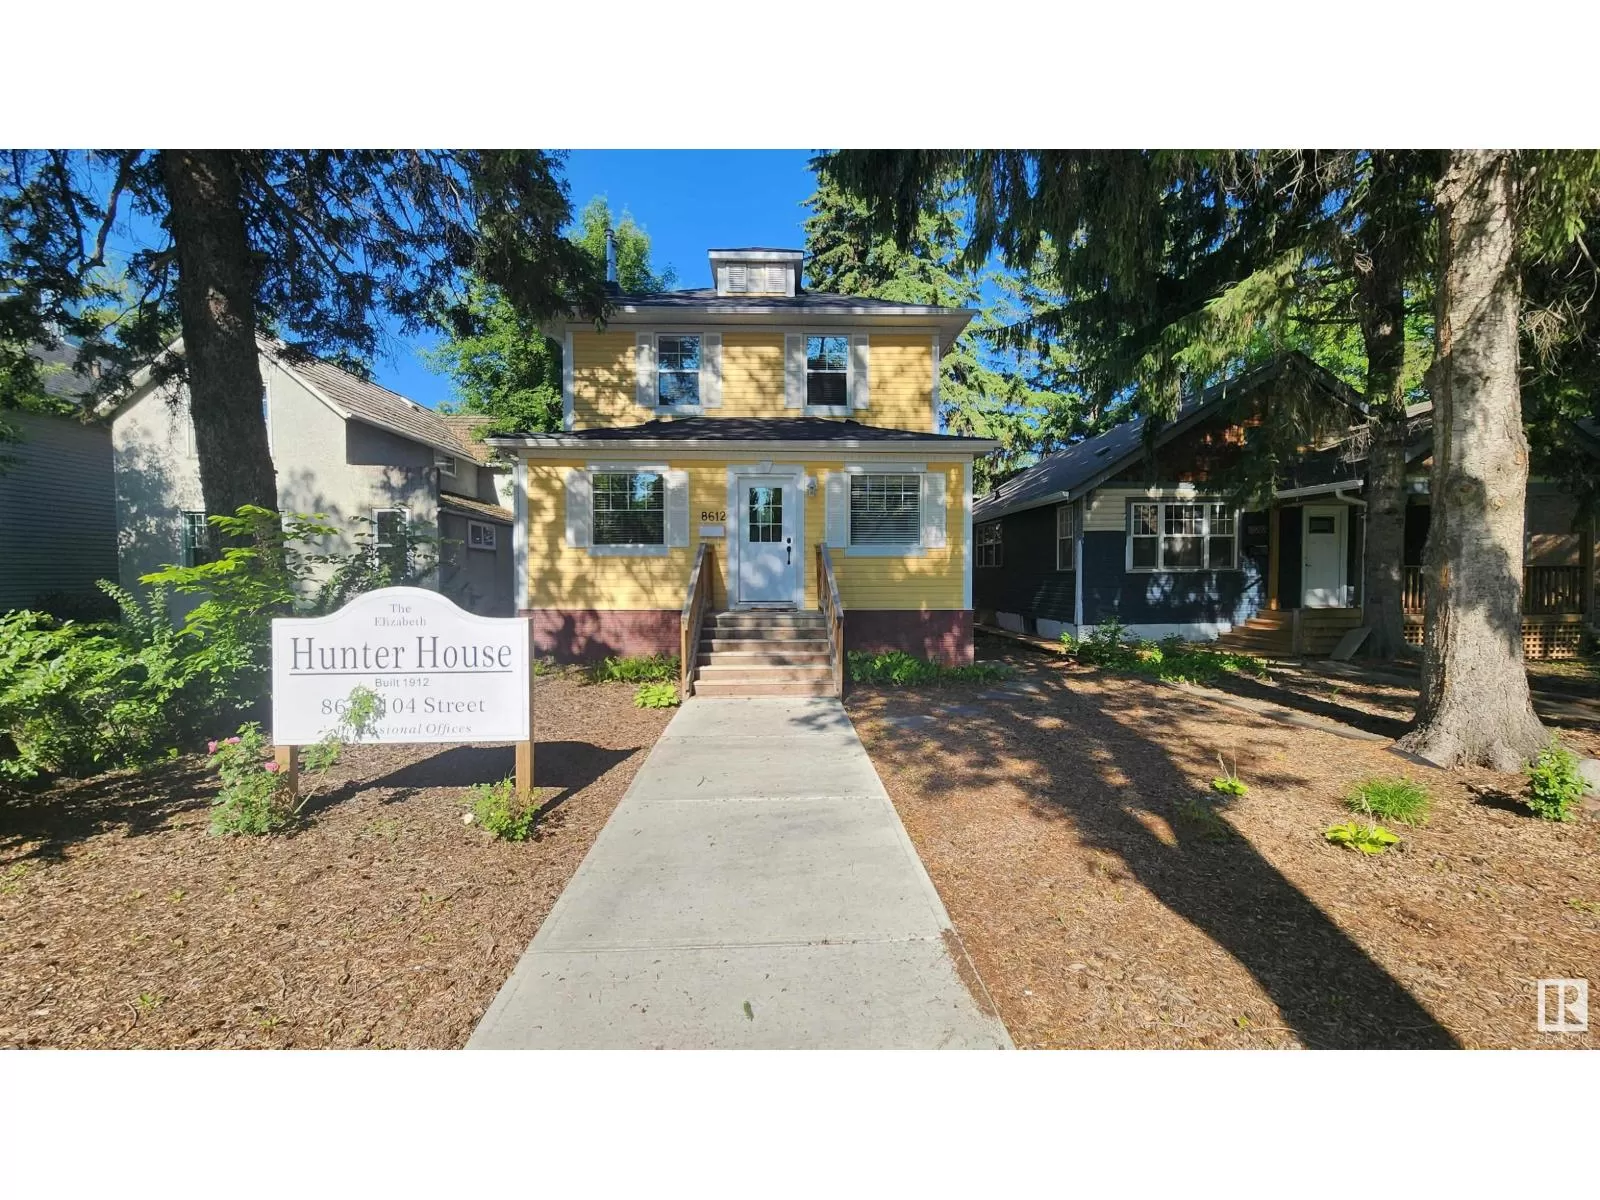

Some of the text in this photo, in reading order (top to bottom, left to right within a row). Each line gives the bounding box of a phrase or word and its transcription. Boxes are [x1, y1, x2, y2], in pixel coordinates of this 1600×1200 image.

[701, 511, 726, 521] 8612
[390, 603, 411, 614] The
[374, 616, 427, 627] Elizabeth
[290, 636, 512, 670] Hunter House
[375, 678, 429, 687] Built 1912
[424, 697, 486, 713] Street
[426, 722, 472, 735] Offices
